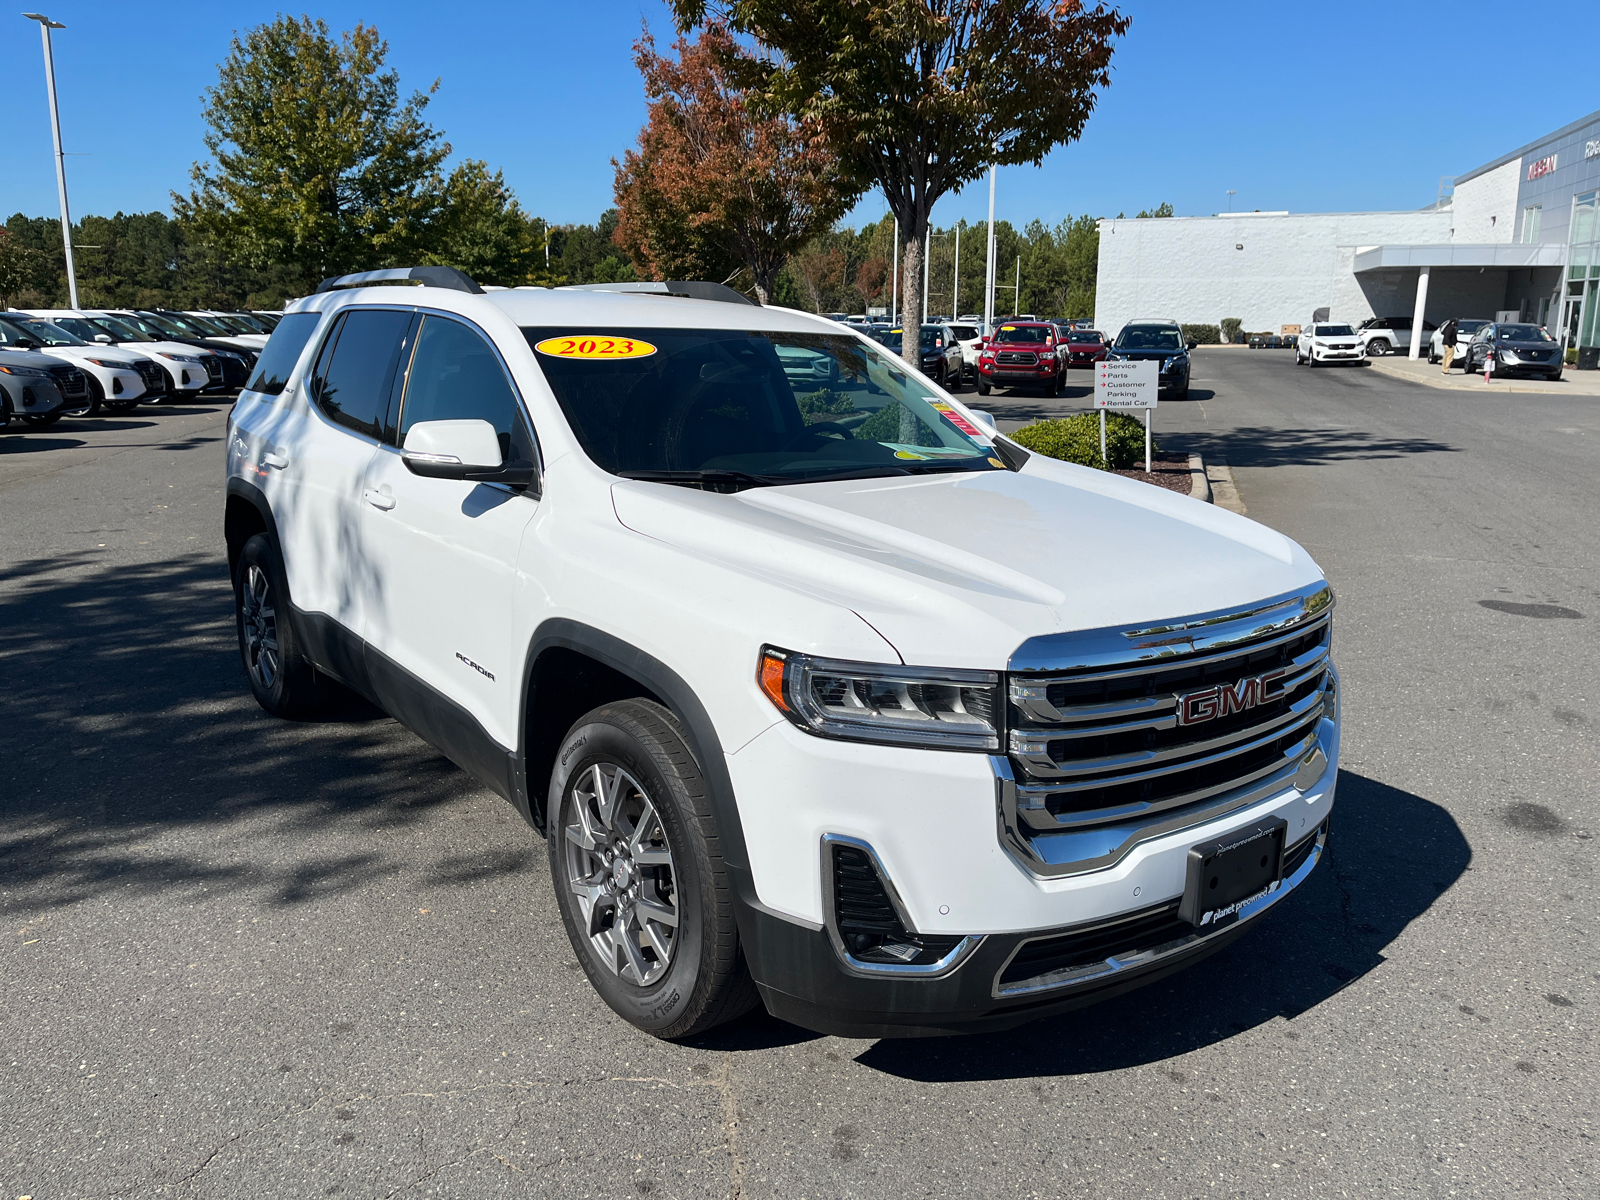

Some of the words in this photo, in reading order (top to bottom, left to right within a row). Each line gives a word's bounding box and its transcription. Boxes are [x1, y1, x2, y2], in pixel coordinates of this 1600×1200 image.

[1527, 154, 1558, 180] NISSAN
[558, 340, 634, 354] 2023
[455, 652, 496, 682] ACADIA
[1176, 668, 1286, 726] GMC
[1213, 903, 1236, 924] planet
[1236, 886, 1268, 913] preowned
